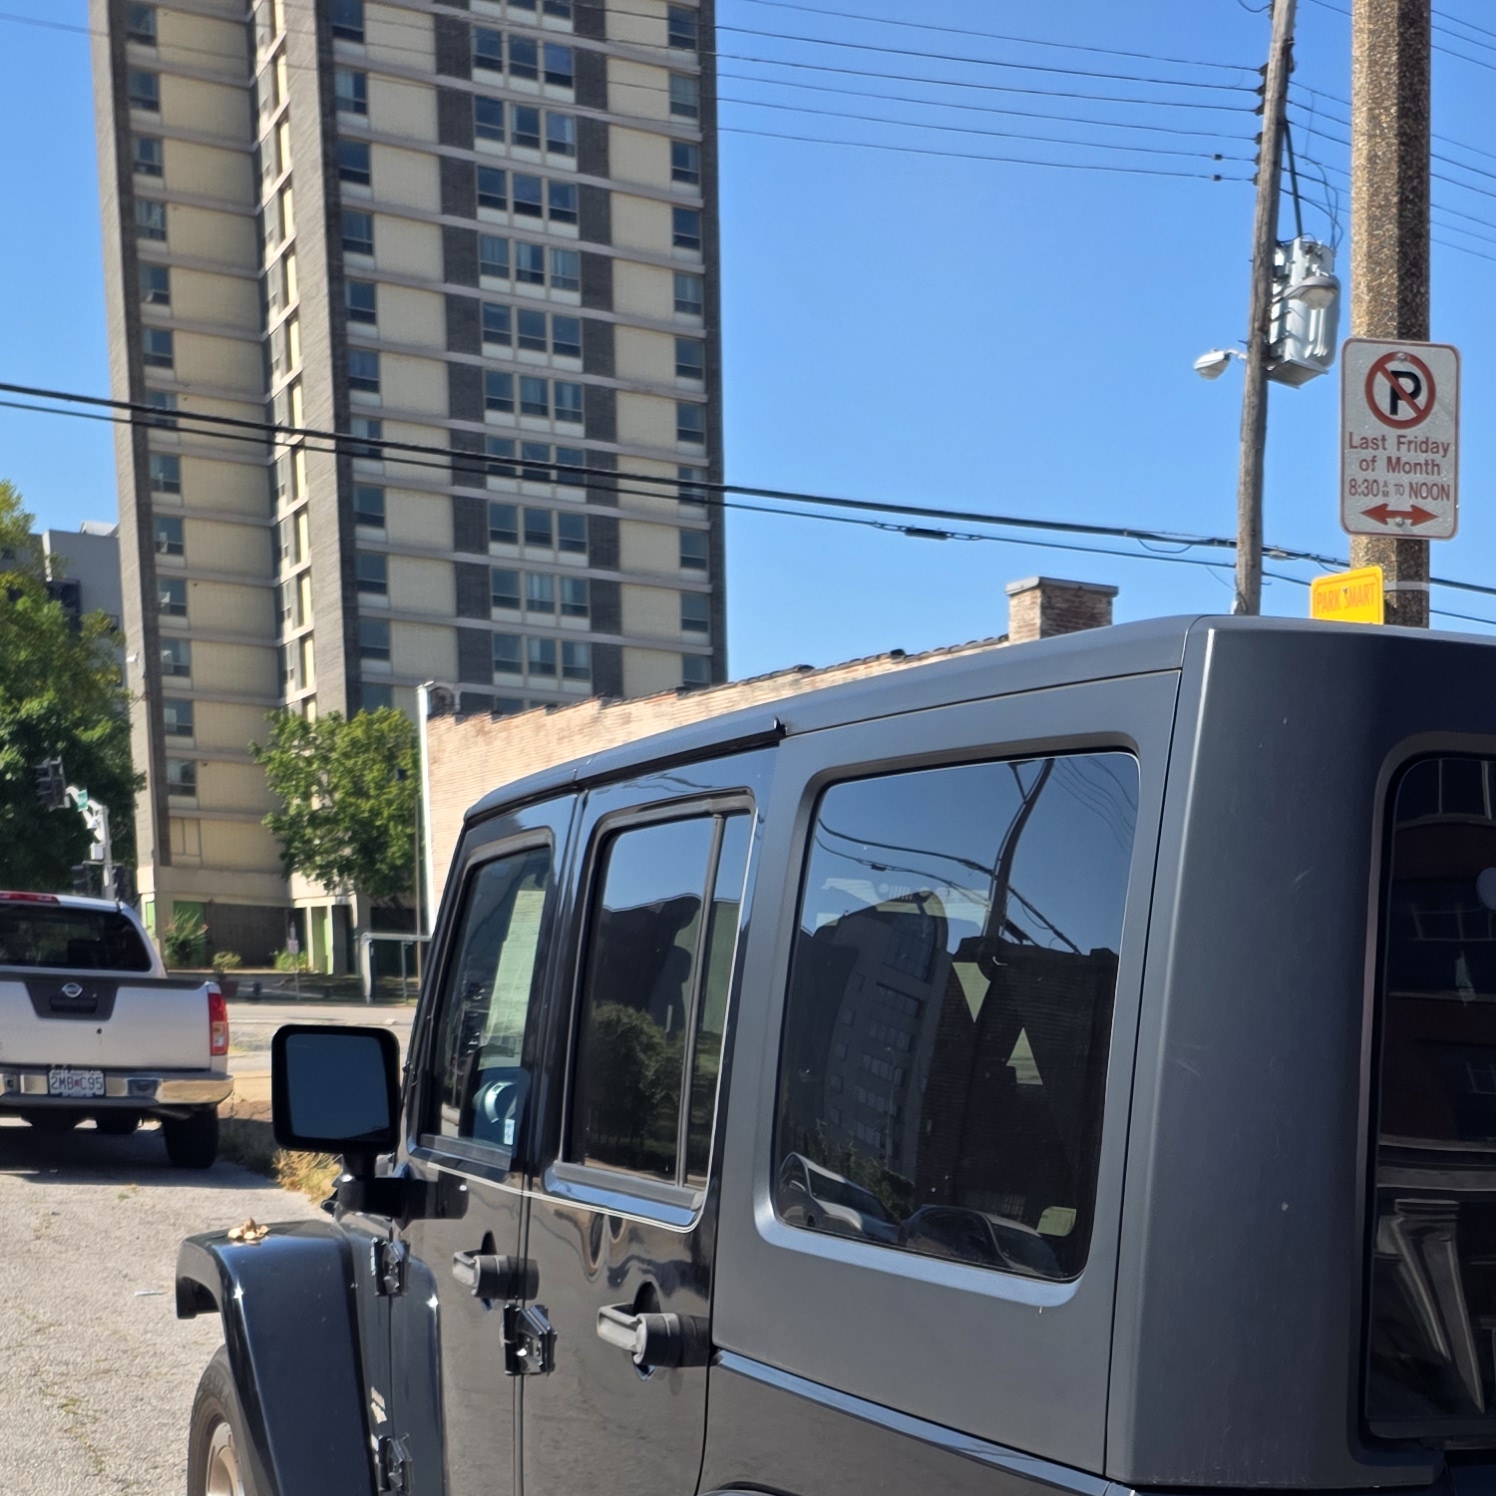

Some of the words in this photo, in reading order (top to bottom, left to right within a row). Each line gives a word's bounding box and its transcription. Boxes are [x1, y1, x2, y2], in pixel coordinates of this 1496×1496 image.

[1349, 432, 1387, 451] Last
[1396, 435, 1450, 458] Friday
[1359, 457, 1377, 473] of
[1386, 456, 1440, 476] Month
[1349, 479, 1380, 498] 8:30
[1394, 484, 1404, 496] TO
[1408, 482, 1450, 501] NOON
[1316, 588, 1341, 615] PARK
[1343, 582, 1376, 610] SMART
